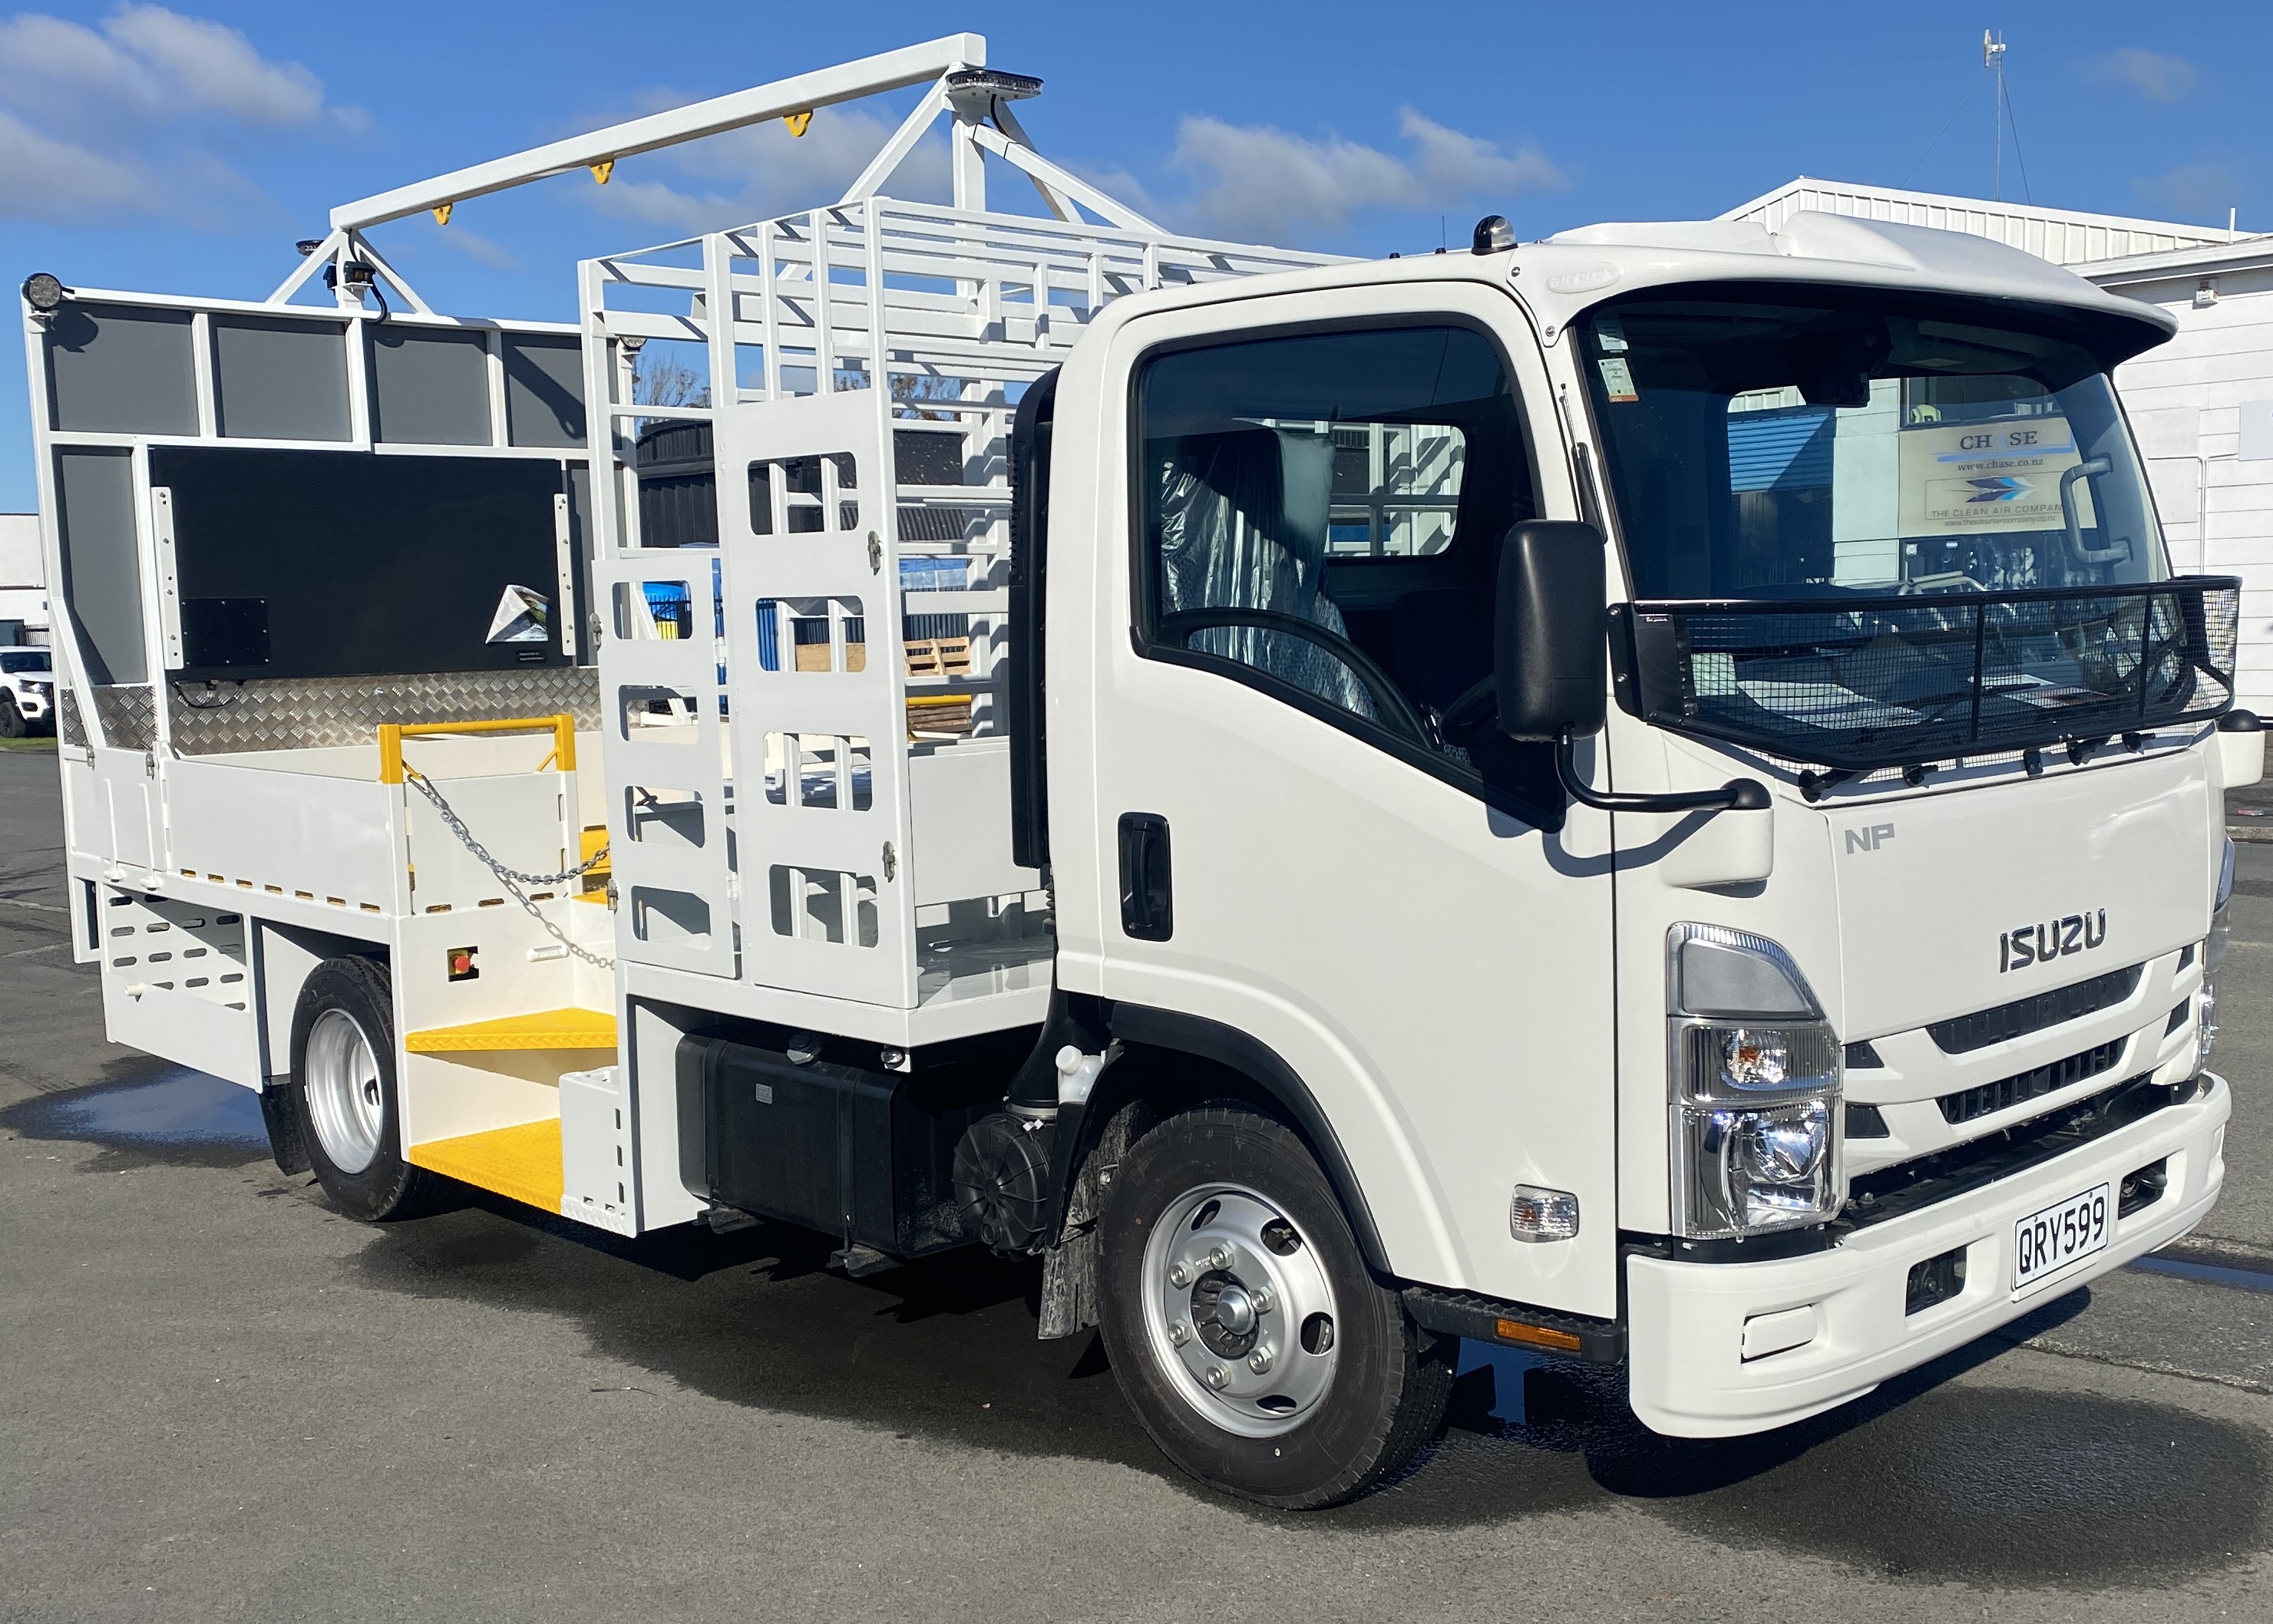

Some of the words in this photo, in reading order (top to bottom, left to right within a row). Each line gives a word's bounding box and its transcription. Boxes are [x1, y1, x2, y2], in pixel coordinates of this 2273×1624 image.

[1957, 458, 2044, 471] www.chase.co.nz
[1931, 510, 1950, 518] THE
[1953, 507, 1988, 517] CLEAN
[1993, 506, 2011, 514] AIR
[2014, 503, 2063, 513] COMPAN
[1844, 823, 1895, 854] NP
[1999, 908, 2106, 974] ISUZU
[2019, 1196, 2105, 1275] QRY599
